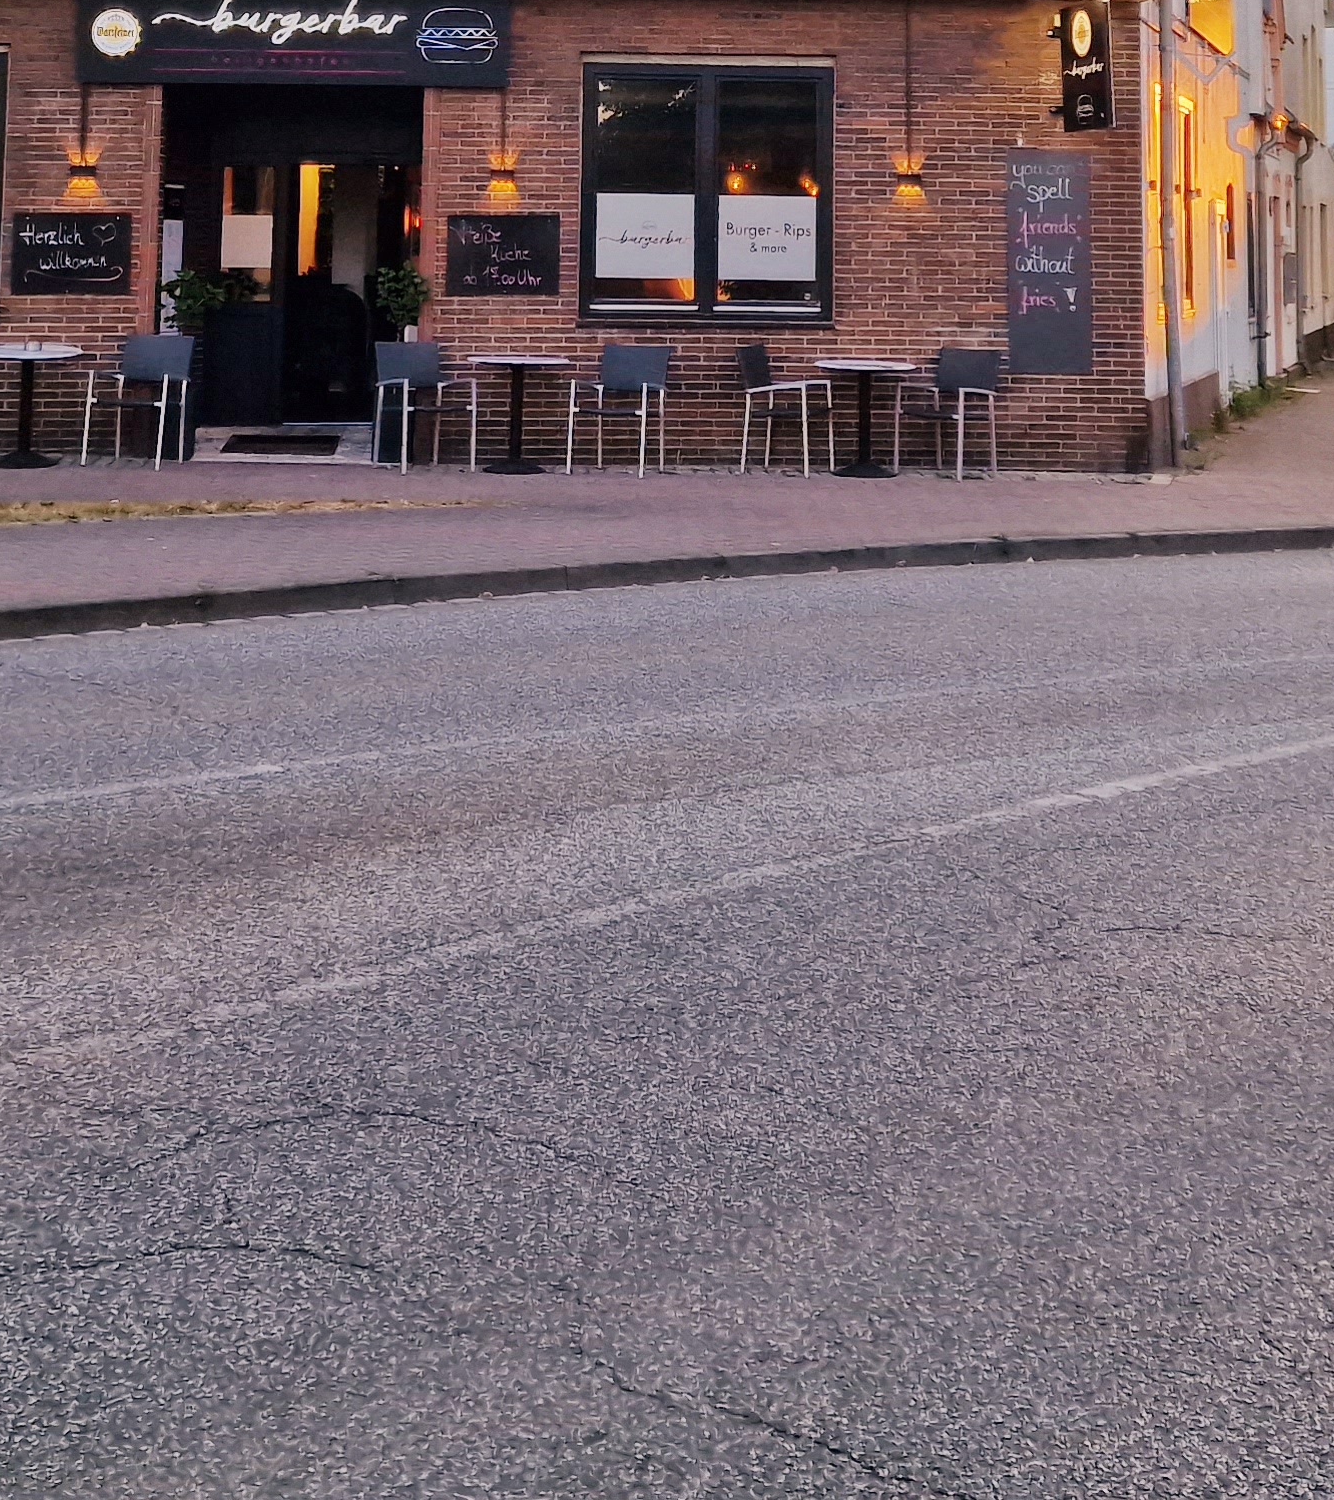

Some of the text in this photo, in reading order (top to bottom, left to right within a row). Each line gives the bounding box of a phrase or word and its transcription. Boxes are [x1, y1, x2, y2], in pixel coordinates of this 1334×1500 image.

[1026, 178, 1073, 213] spell
[19, 222, 85, 246] Herzlich
[726, 221, 771, 238] Burger
[784, 222, 811, 240] Rips
[1019, 211, 1077, 248] friends
[749, 243, 787, 253] & more
[1015, 246, 1076, 274] without
[517, 269, 542, 287] Uhr
[1021, 286, 1057, 315] fries
